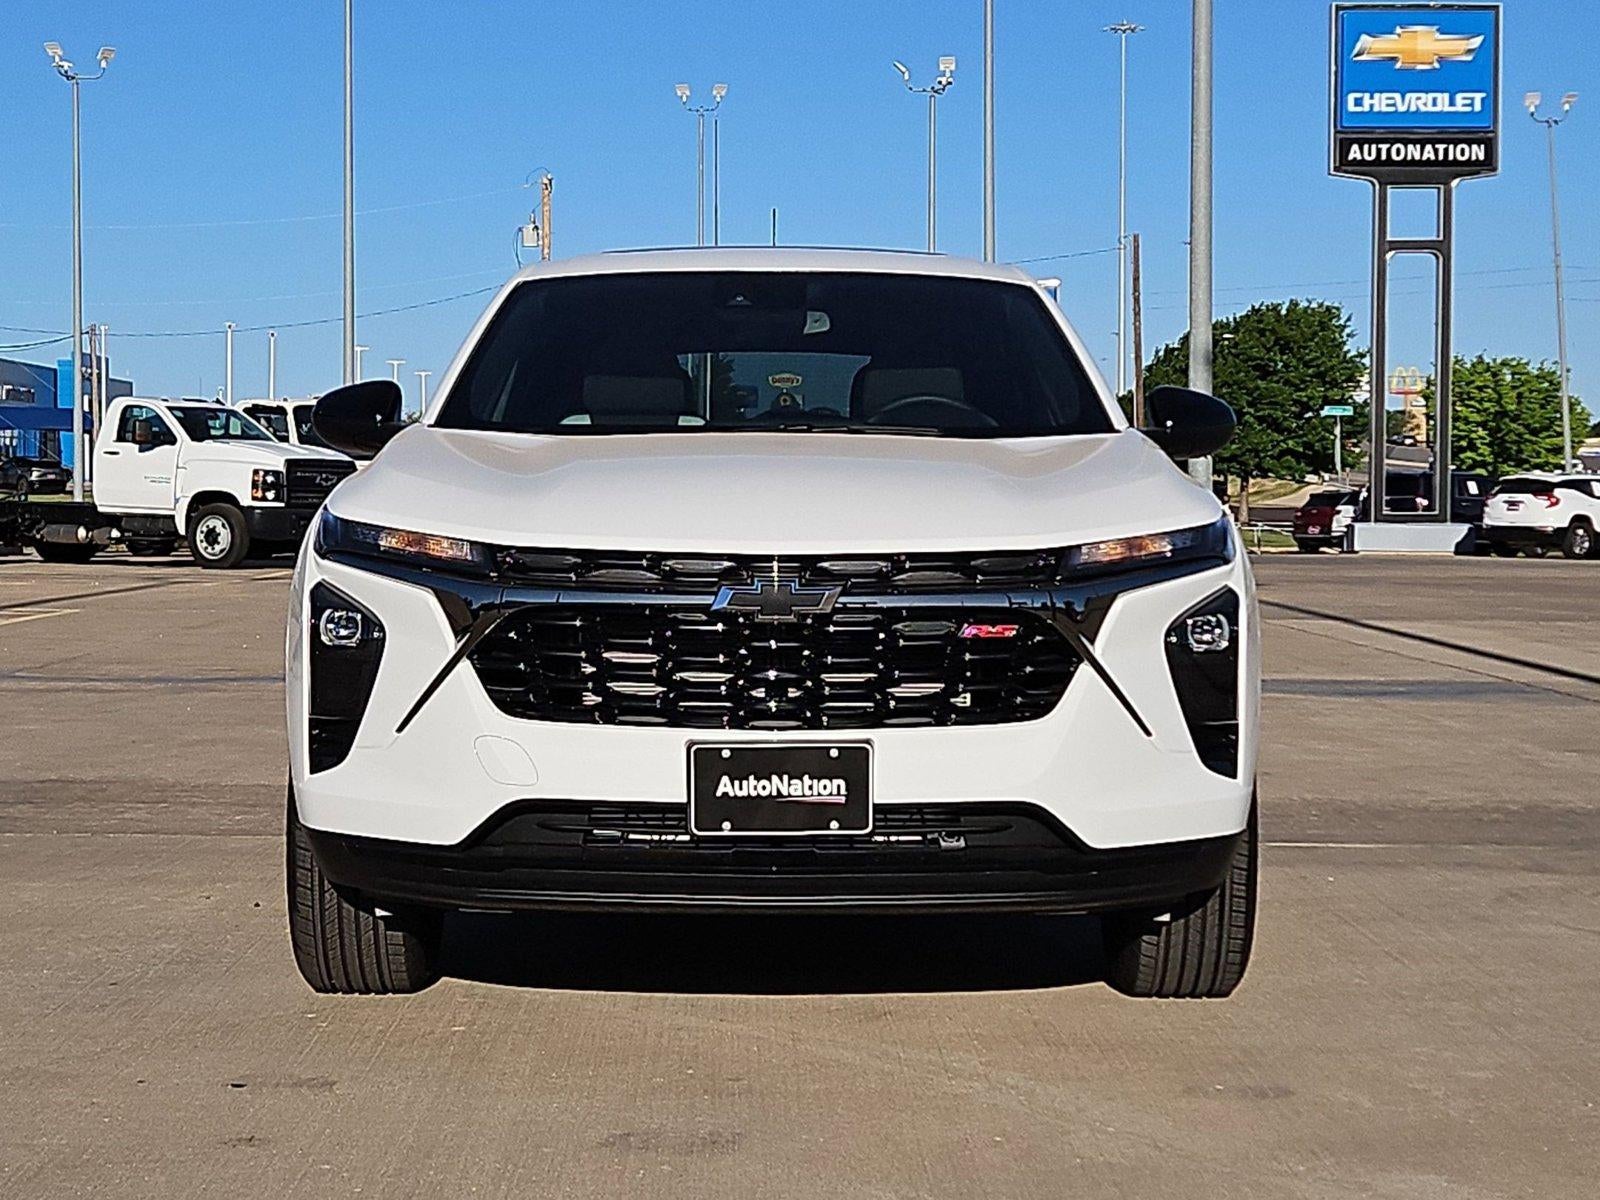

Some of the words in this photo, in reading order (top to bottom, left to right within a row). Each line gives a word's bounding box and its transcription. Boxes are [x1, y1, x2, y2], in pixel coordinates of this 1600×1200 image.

[1347, 92, 1487, 112] CHEVROLET
[1347, 143, 1485, 161] AUTONATION
[716, 774, 848, 797] AutoNation
